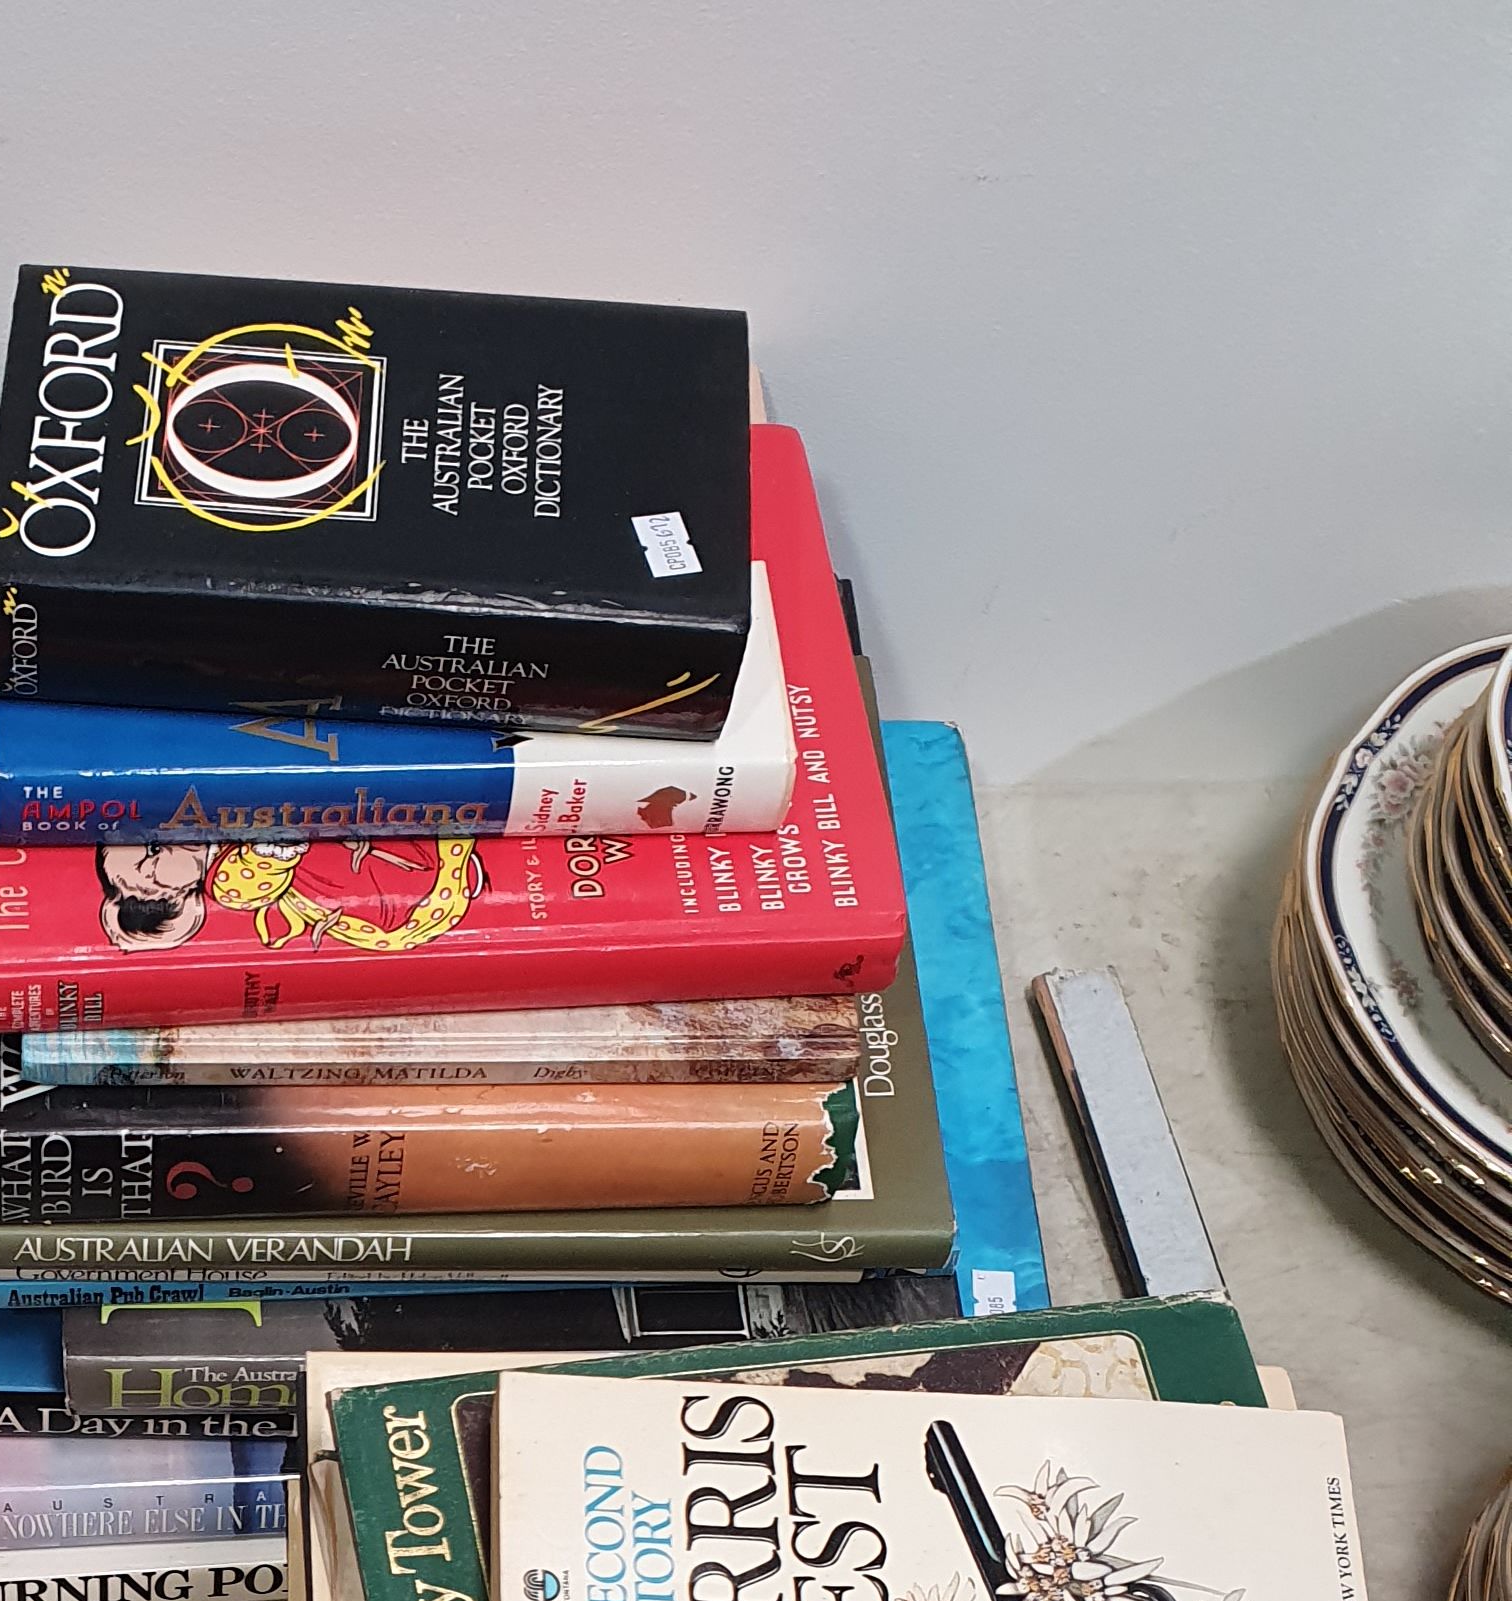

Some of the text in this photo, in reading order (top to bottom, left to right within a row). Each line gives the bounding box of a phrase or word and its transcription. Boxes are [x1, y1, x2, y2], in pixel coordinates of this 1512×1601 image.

[18, 282, 125, 557] OXFORD
[400, 417, 430, 465] THE
[431, 372, 466, 517] AUSTRALIAN
[466, 401, 497, 492] POCKET
[499, 402, 531, 497] OXFORD
[533, 383, 565, 519] DICTIONARY
[12, 602, 39, 697] OXFORD
[381, 653, 550, 680] AUSTRALIAN
[443, 634, 496, 656] THE
[406, 692, 512, 713] OXFORD
[410, 675, 515, 695] POCKET
[22, 799, 143, 822] AMPOL
[23, 785, 64, 800] THE
[159, 784, 489, 830] Australiana
[557, 777, 588, 823] Baker
[786, 683, 859, 908] BLINKY BILL AND NUTSY
[22, 820, 87, 833] BOOK
[525, 868, 548, 920] STORY
[670, 833, 700, 914] INCLUDING
[706, 845, 742, 913] BLINKY
[748, 844, 786, 911] BLINKY
[861, 991, 899, 1099] Douglass
[374, 1065, 488, 1080] MATILDA
[532, 1065, 587, 1081] Digby
[760, 1121, 780, 1152] AND
[0, 1128, 33, 1223] WHAT
[40, 1132, 73, 1217] BIRD
[81, 1166, 114, 1199] IS
[121, 1129, 154, 1220] THAT
[13, 1236, 215, 1263] AUSTRALIAN
[225, 1236, 413, 1264] VERANDAH
[7, 1284, 205, 1308] Australian Pub Crawl
[188, 1365, 230, 1382] The
[40, 1409, 134, 1437] Day
[140, 1416, 191, 1435] in
[199, 1413, 277, 1436] the
[382, 1404, 451, 1578] Tower
[1325, 1476, 1345, 1530] TIMES
[1, 1504, 244, 1542] NOWHERE ELSE IN
[1333, 1532, 1353, 1579] YORK
